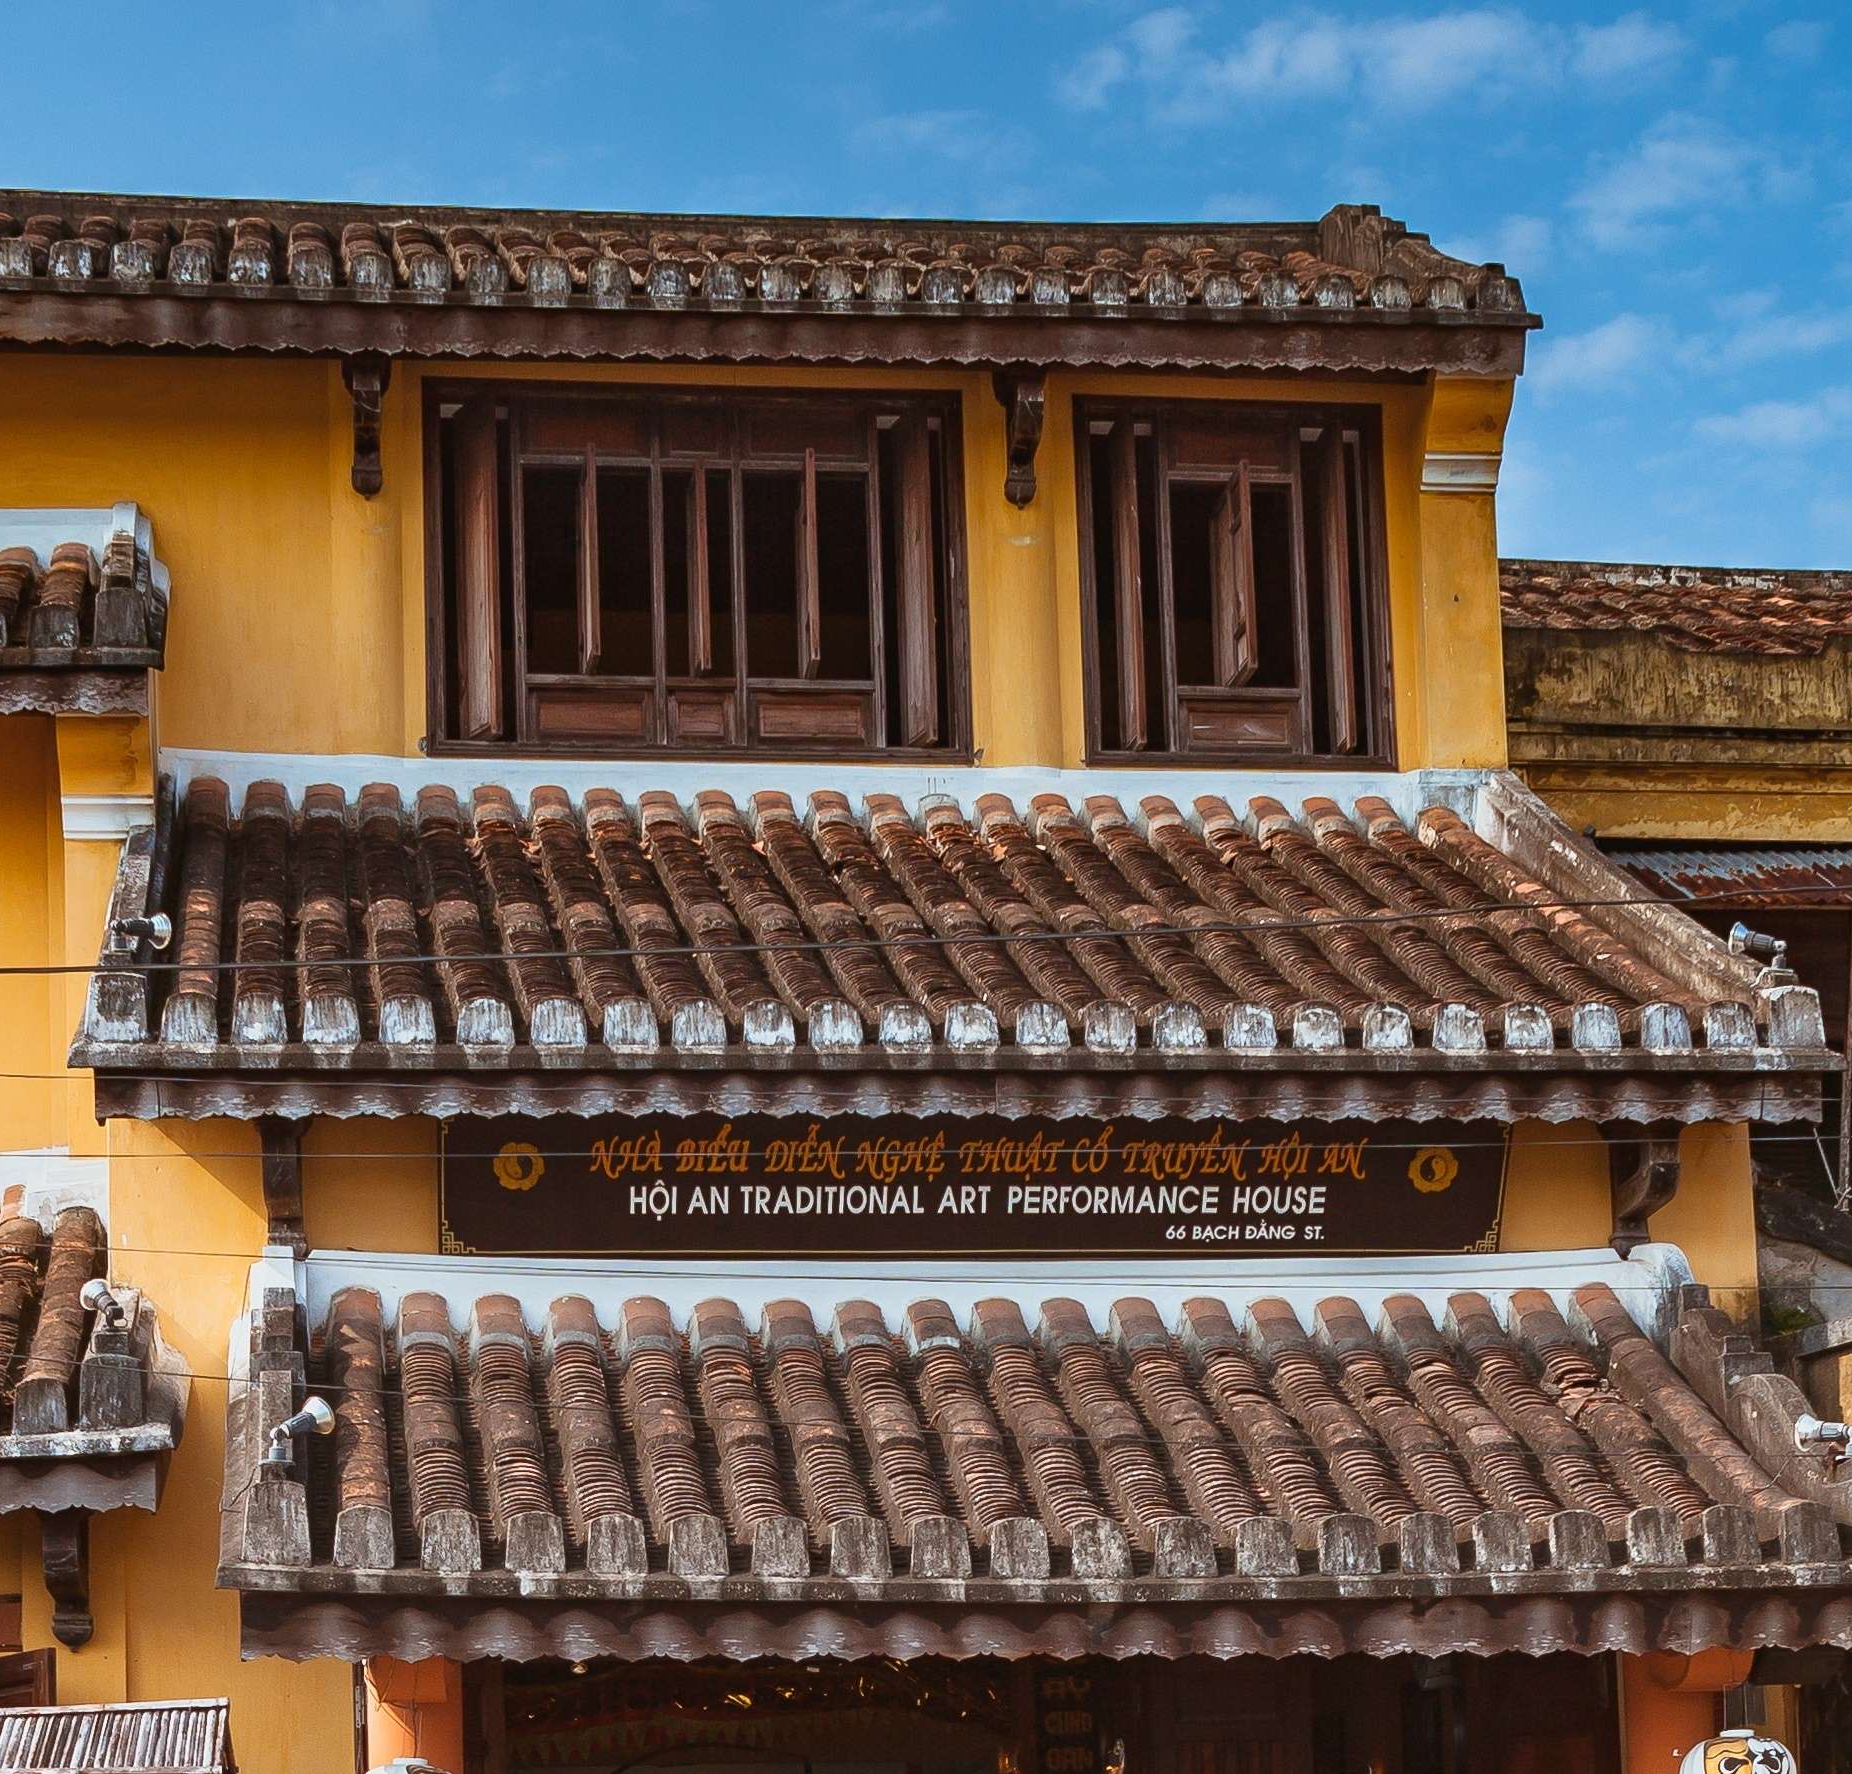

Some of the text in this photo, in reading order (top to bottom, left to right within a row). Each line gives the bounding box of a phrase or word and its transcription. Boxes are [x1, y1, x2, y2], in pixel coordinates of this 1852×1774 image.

[590, 1123, 1367, 1183] NHÀ BIỂU DIỄN NGHỆ THUẬT CỔ TRUYỀN HỘI AN
[630, 1179, 1327, 1221] HỘI AN TRADITIONAL ART PERFORMANCE HOUSE
[1165, 1219, 1325, 1242] 66 BẠCH ĐẰNG ST.
